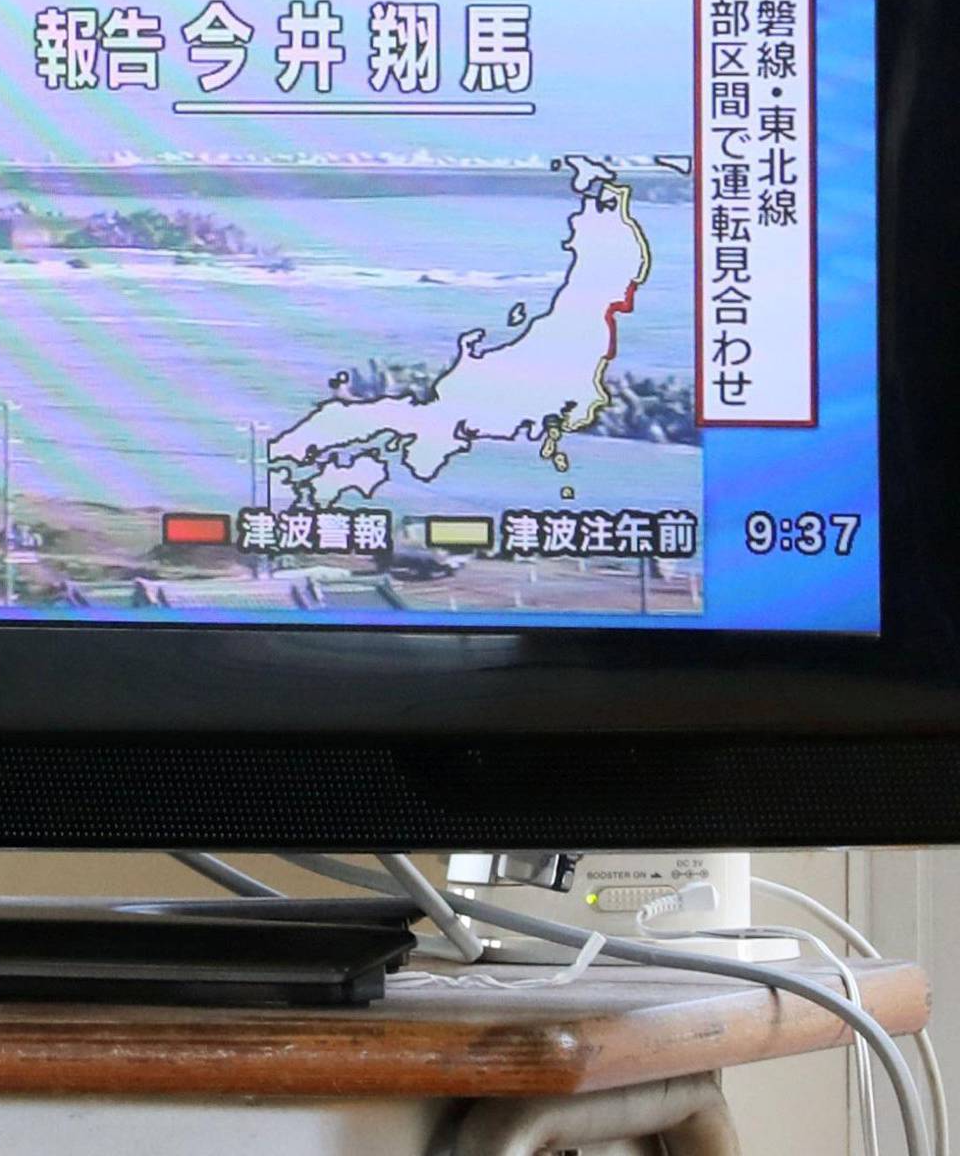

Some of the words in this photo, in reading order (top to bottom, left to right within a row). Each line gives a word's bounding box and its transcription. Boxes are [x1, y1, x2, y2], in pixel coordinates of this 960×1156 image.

[35, 6, 165, 91] 報告
[180, 0, 535, 93] 今井翔馬
[240, 511, 388, 551] 津波警報
[746, 513, 860, 554] 9:37
[586, 870, 631, 880] BOOSTER
